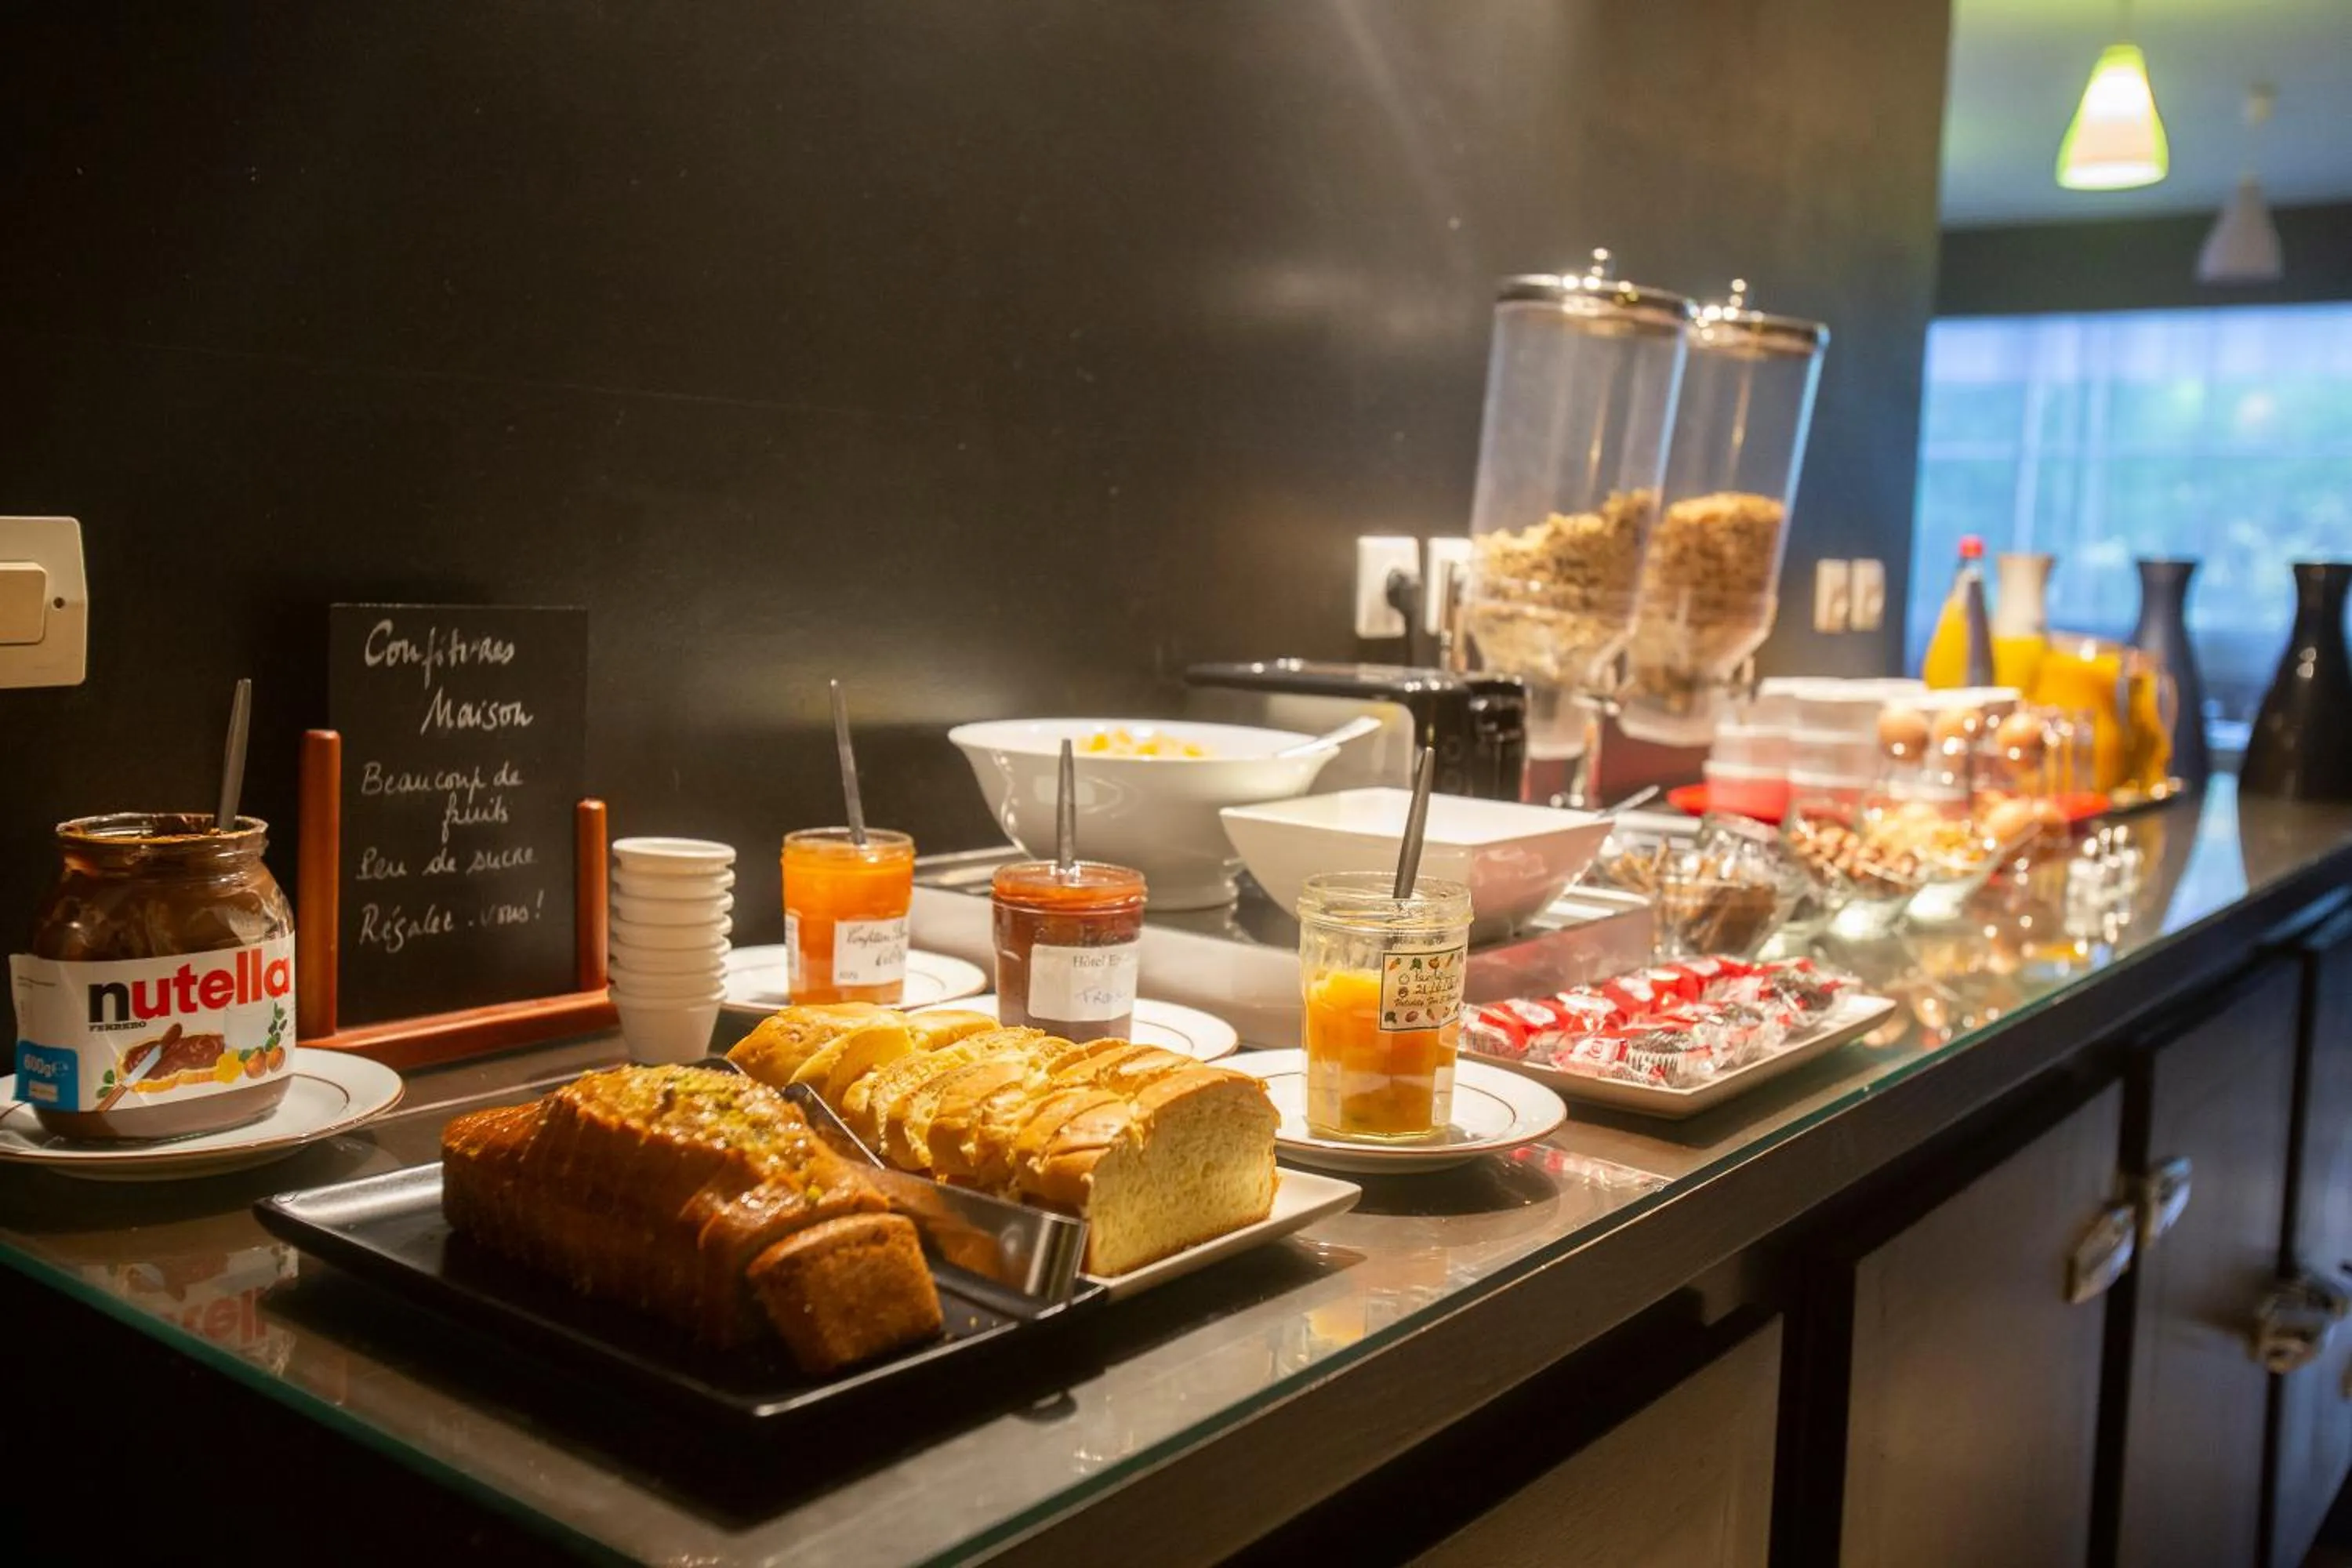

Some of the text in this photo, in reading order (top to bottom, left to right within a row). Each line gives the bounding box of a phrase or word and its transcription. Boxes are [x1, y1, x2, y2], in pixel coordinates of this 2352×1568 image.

[420, 686, 534, 735] Maison
[361, 760, 523, 804] Beaucoup de
[441, 791, 509, 845] fruits
[356, 846, 535, 880] Peu de sucre
[88, 948, 291, 1023] nutella
